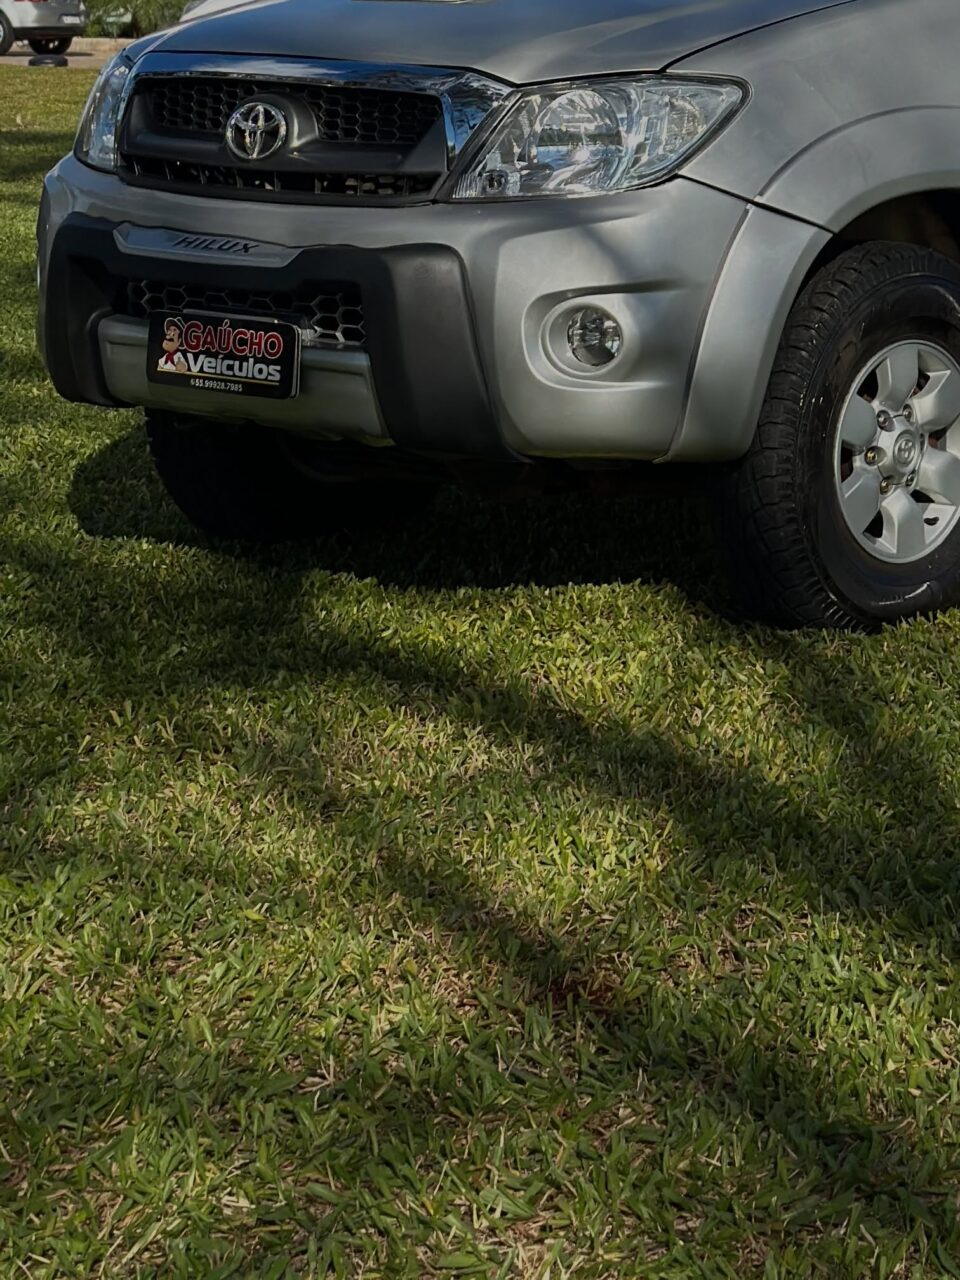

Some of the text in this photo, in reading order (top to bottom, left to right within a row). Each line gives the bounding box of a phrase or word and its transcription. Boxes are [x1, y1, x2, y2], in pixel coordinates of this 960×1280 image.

[173, 236, 260, 253] HILUX
[183, 319, 283, 359] GAÚCHO
[187, 353, 281, 381] Veículos
